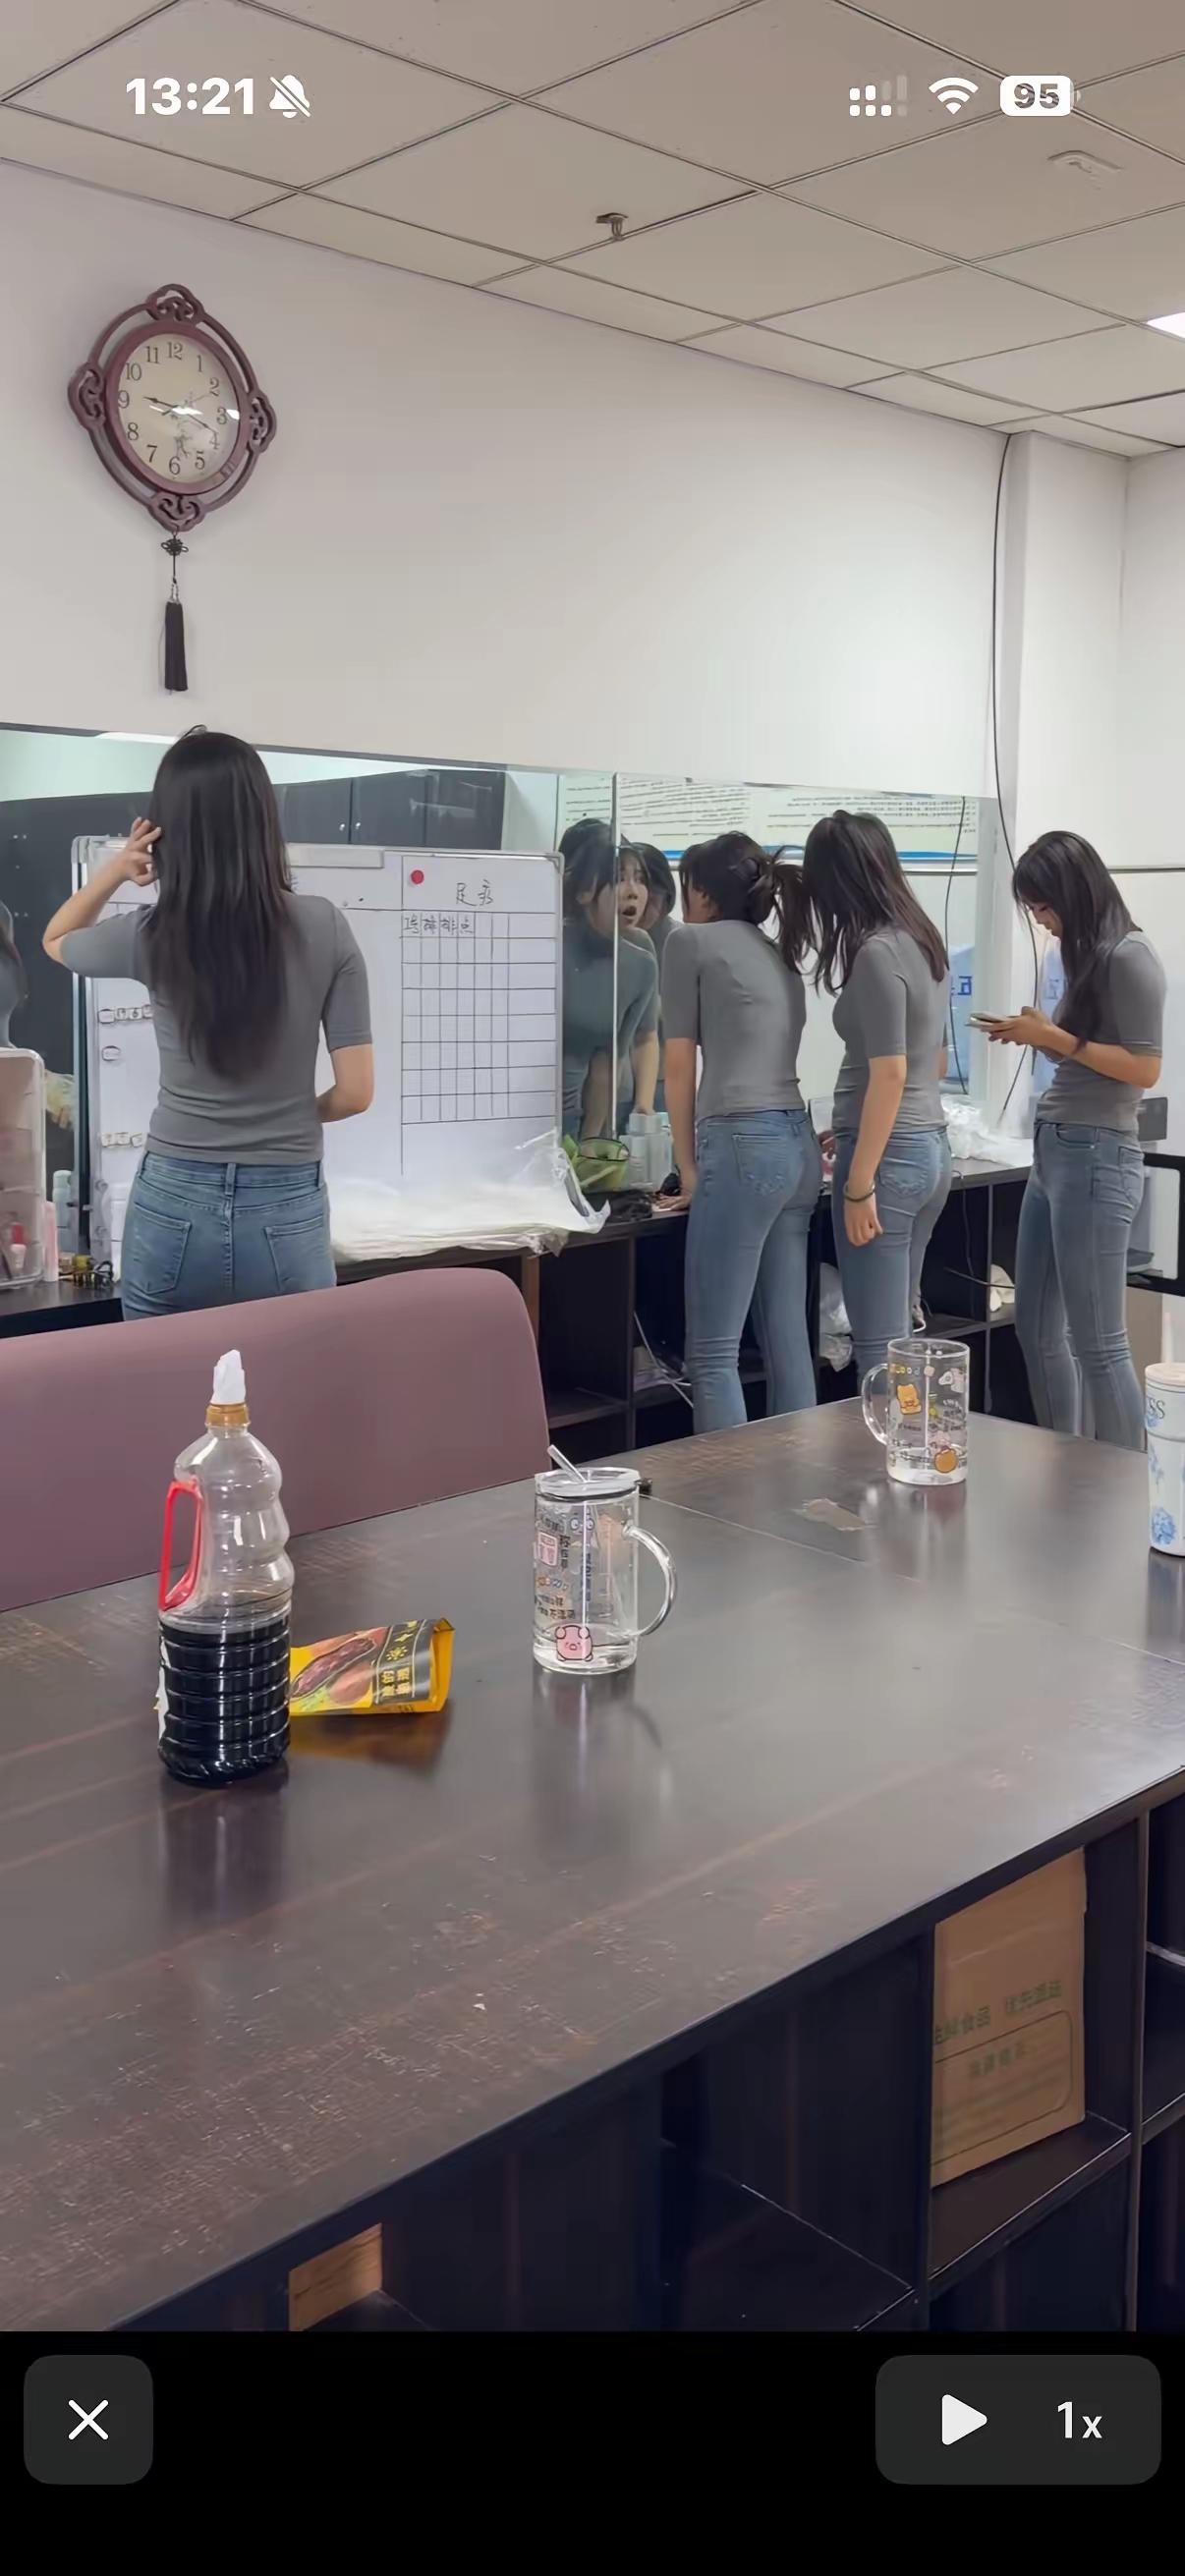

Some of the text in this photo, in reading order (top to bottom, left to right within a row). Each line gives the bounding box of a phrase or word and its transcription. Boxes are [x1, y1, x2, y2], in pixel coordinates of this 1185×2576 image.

[146, 345, 160, 364] 11
[167, 341, 183, 361] 12
[126, 362, 142, 381] 10
[198, 354, 202, 372] 1
[209, 376, 219, 396] 2
[117, 389, 130, 409] 9
[216, 405, 227, 425] 3
[127, 421, 140, 441] 8
[147, 444, 158, 463] 7
[195, 450, 205, 470] 5
[168, 456, 181, 476] 6
